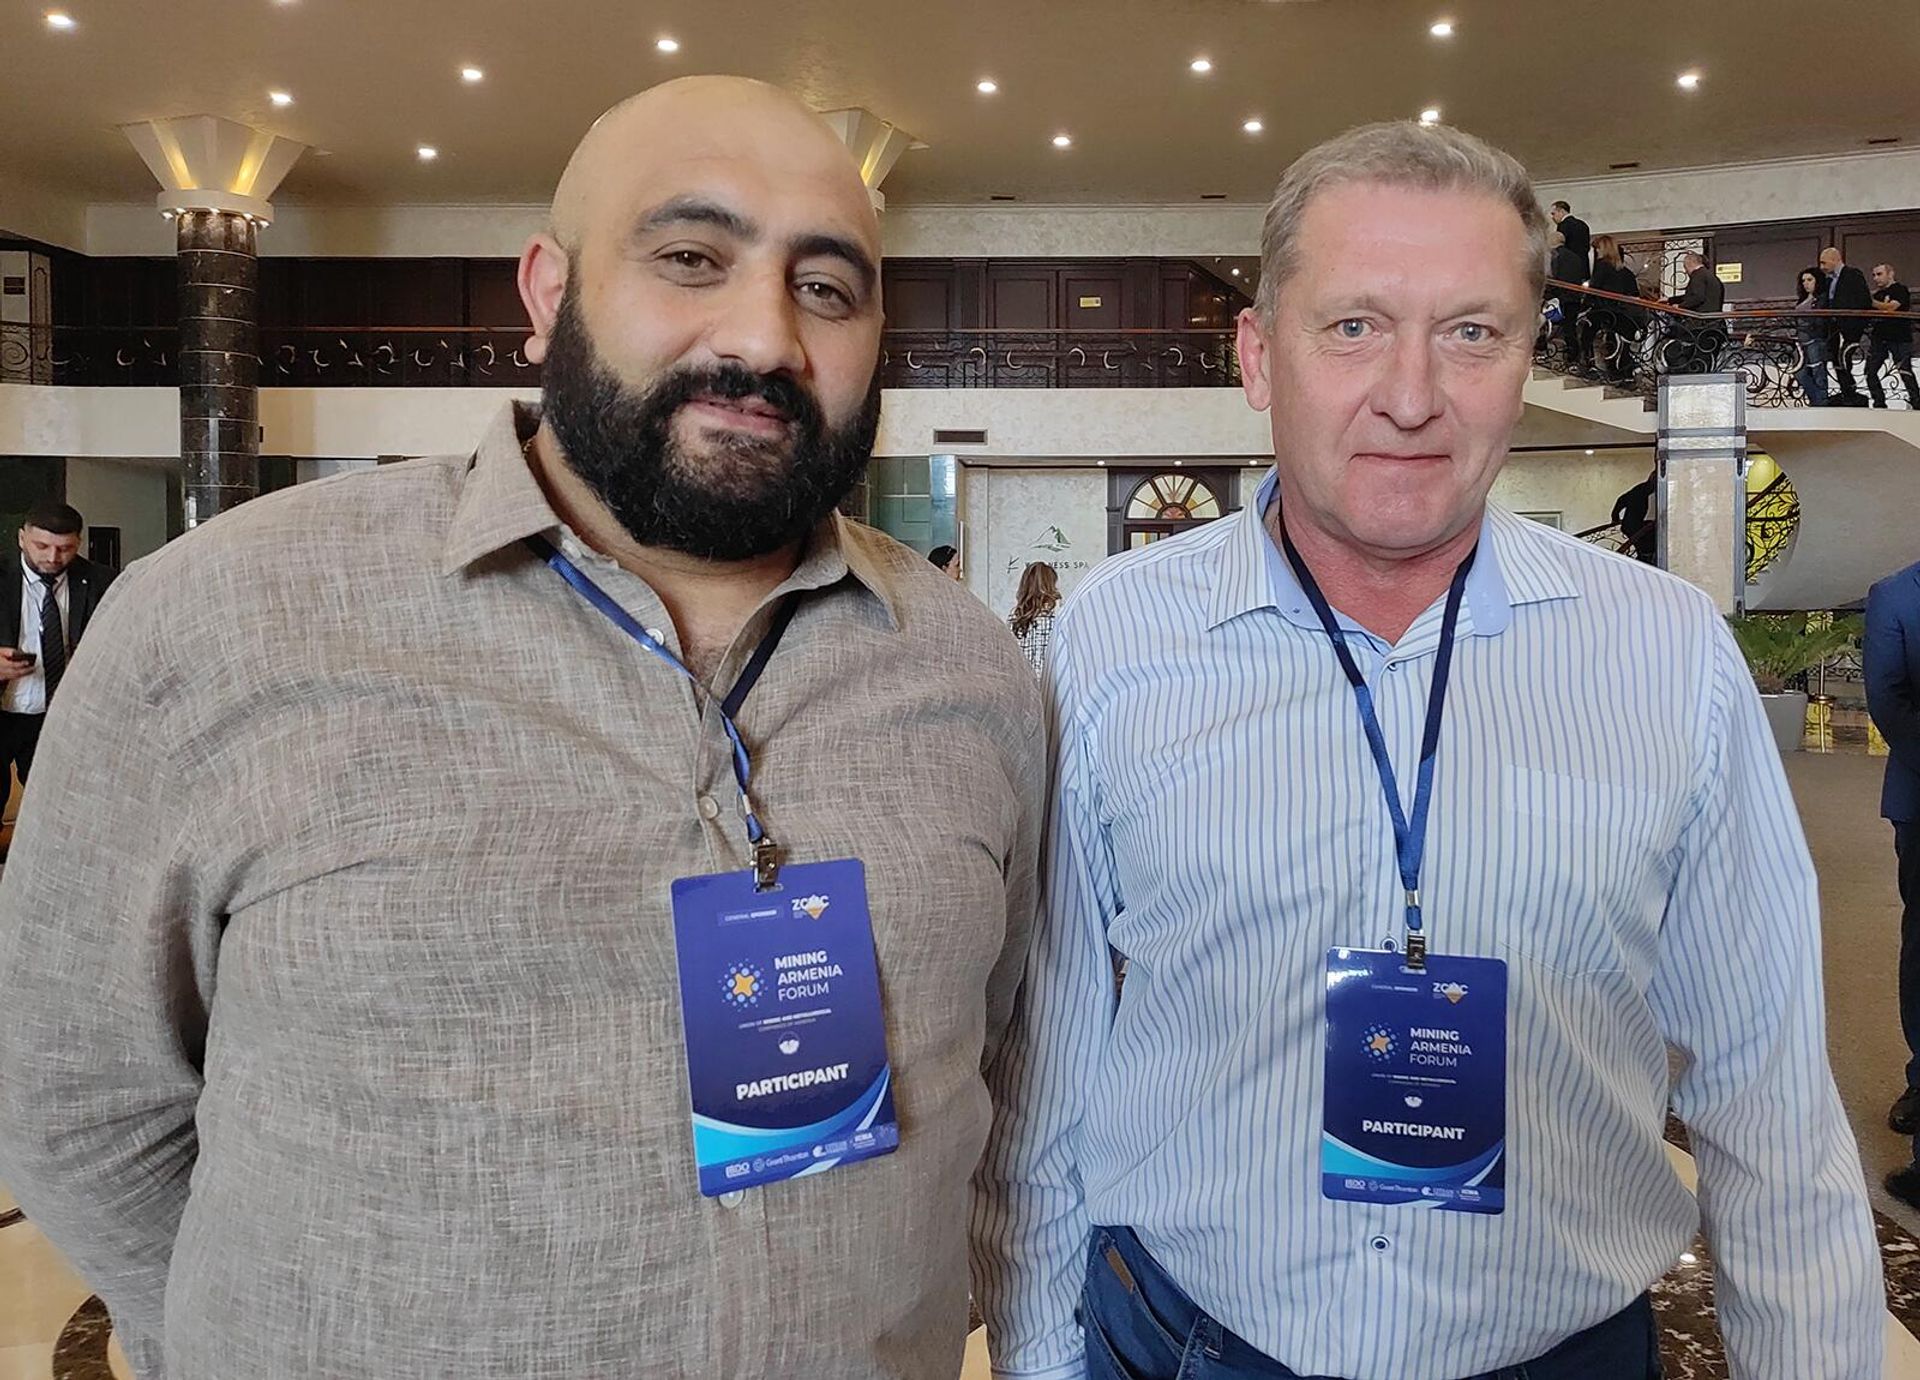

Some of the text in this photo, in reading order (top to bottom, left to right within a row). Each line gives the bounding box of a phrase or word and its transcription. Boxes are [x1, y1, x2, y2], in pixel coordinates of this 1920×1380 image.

[774, 950, 828, 970] MINING
[777, 965, 843, 986] ARMENIA
[778, 981, 830, 1002] FORUM
[1410, 1026, 1461, 1041] MINING
[1410, 1041, 1472, 1056] ARMENIA
[1409, 1053, 1457, 1068] FORUM
[736, 1063, 849, 1100] PARTICIPANT
[1362, 1119, 1466, 1141] PARTICIPANT
